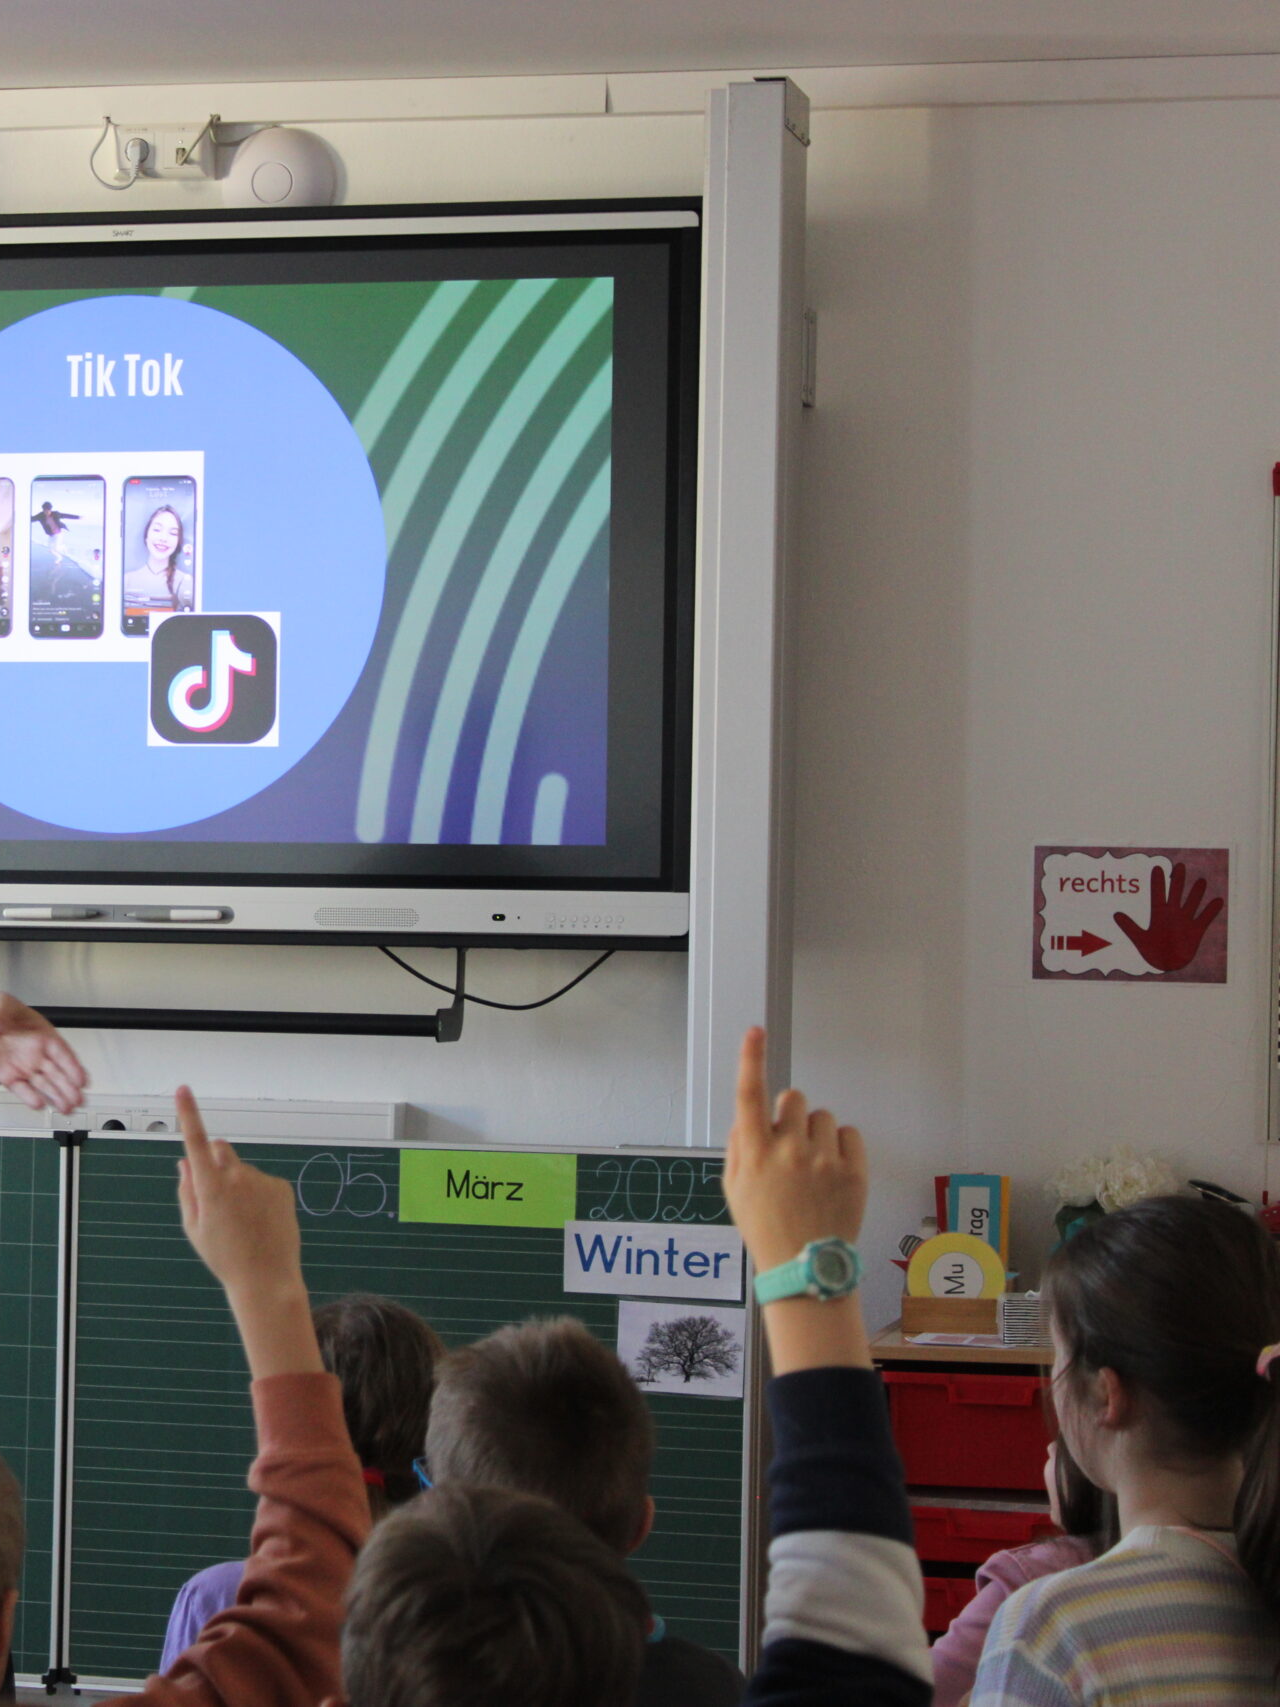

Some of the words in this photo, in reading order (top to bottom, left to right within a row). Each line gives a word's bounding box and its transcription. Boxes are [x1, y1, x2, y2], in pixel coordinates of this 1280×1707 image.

[66, 352, 116, 397] Tik
[124, 353, 184, 396] Tok
[1059, 870, 1140, 894] rechts
[446, 1169, 524, 1202] März
[589, 1158, 729, 1222] 2025
[969, 1208, 989, 1236] rag
[574, 1233, 731, 1279] Winter
[943, 1264, 965, 1295] Mu
